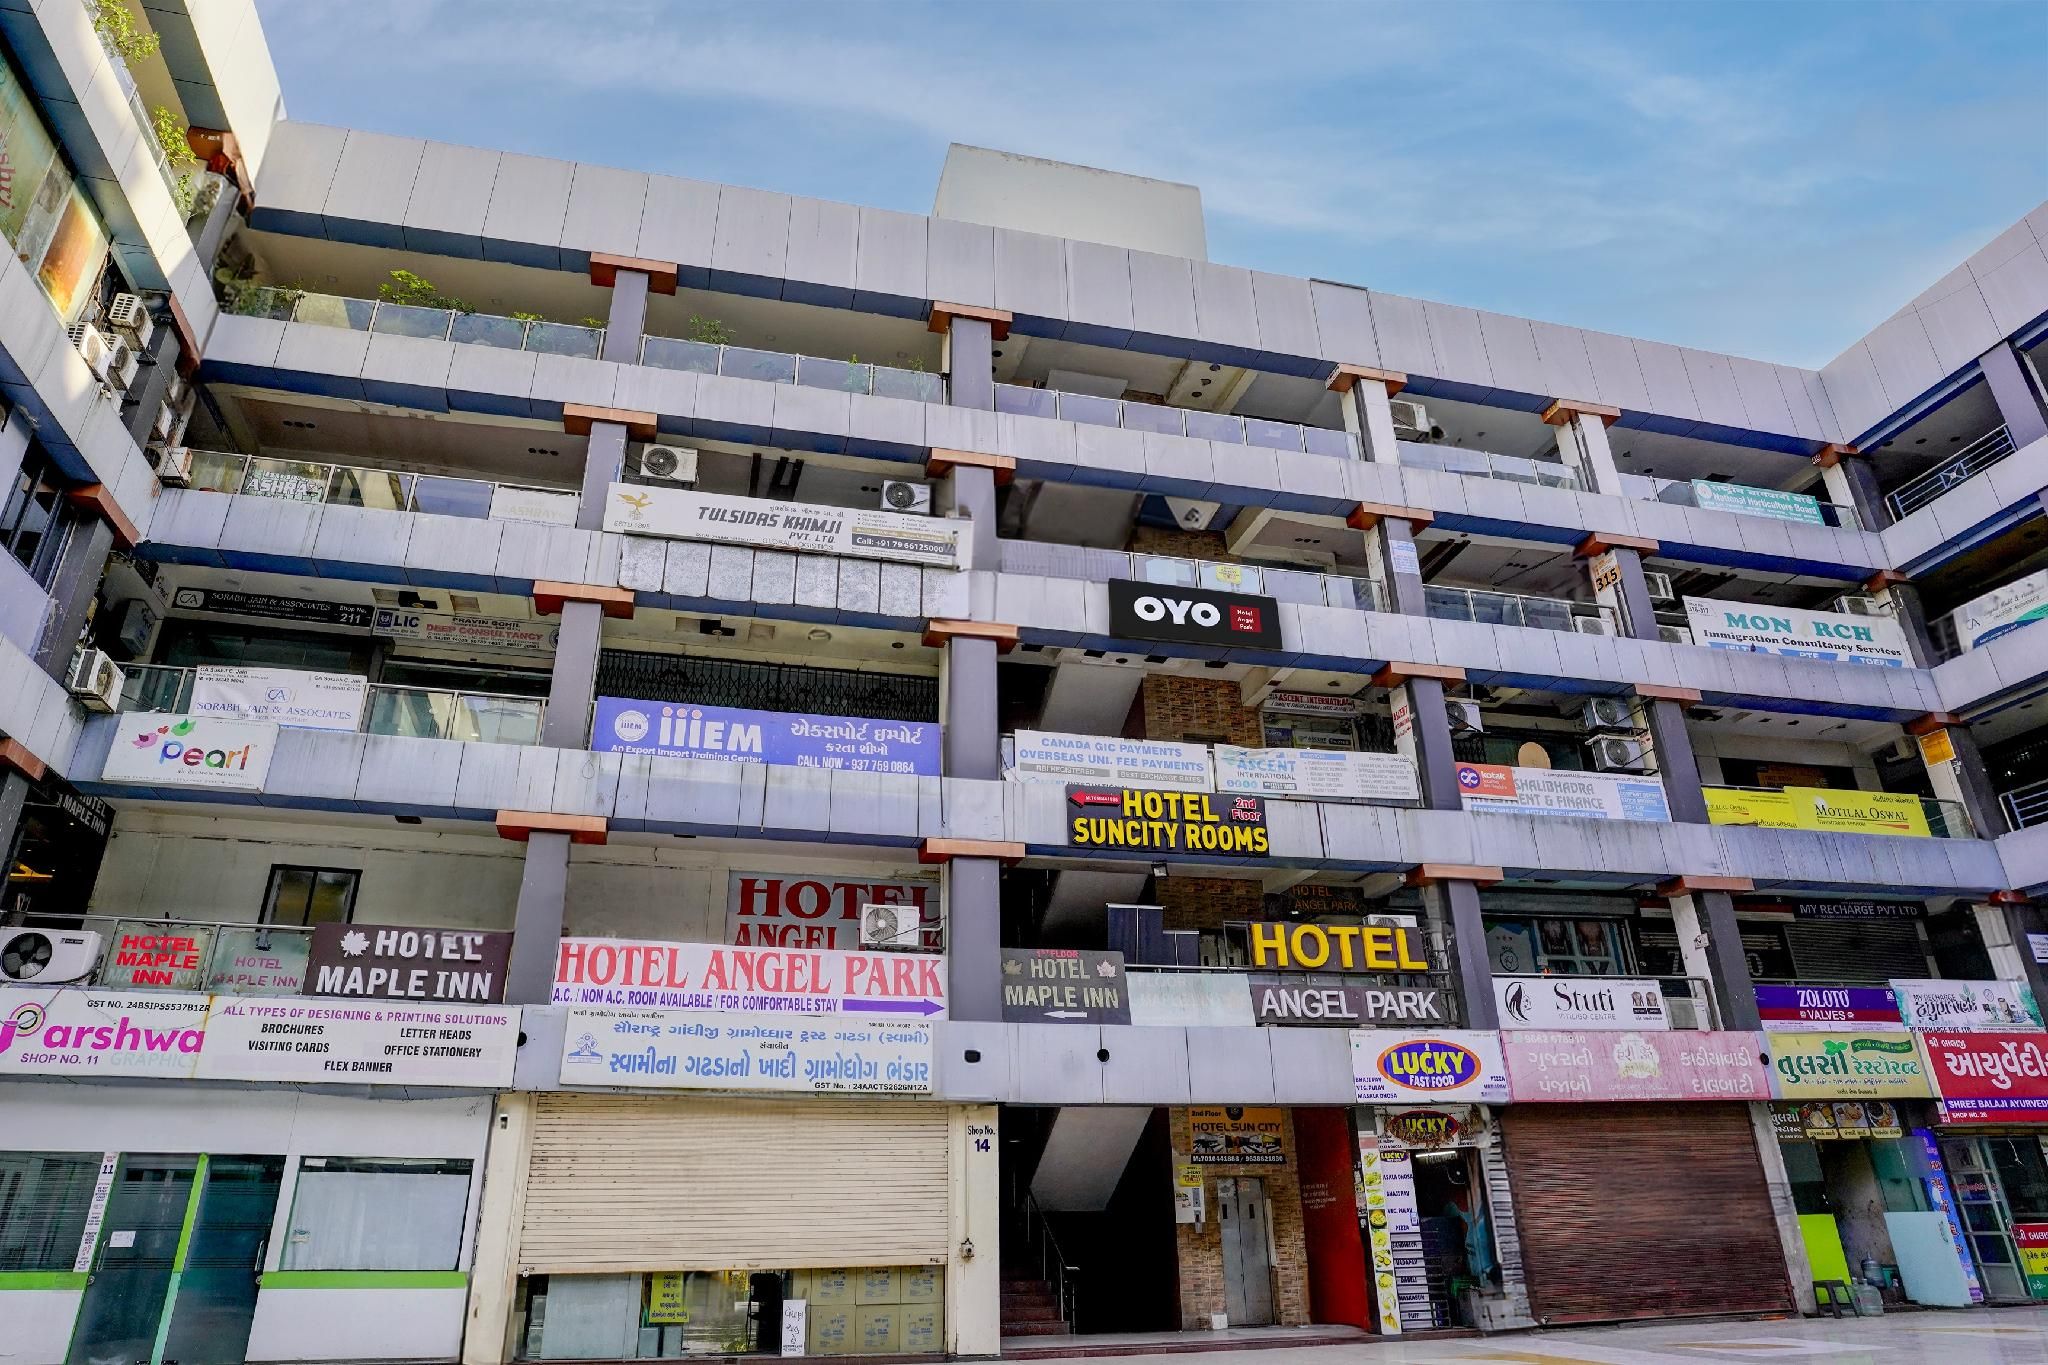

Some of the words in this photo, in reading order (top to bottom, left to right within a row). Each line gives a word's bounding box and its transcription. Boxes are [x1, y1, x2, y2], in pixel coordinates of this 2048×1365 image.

[1713, 493, 1746, 505] National
[1748, 498, 1794, 510] Horticulture
[1795, 504, 1817, 514] Board
[698, 506, 779, 528] TULSIDAS
[783, 515, 842, 534] KHIMJI
[788, 531, 811, 541] PVT.
[856, 537, 874, 545] Call:
[876, 538, 890, 547] +91
[903, 542, 944, 553] 66125000
[1595, 567, 1619, 592] 315
[211, 592, 247, 602] SORABH
[248, 595, 268, 605] JAIN
[270, 597, 278, 606] &
[278, 599, 331, 611] ASSOCIATES
[356, 606, 367, 614] No.
[339, 613, 361, 624] 211
[394, 612, 420, 627] LIC
[1133, 596, 1221, 627] OYO
[426, 623, 456, 633] DEEP
[458, 626, 543, 641] CONSULTANCY
[1703, 629, 1779, 645] Immigration
[1782, 637, 1852, 652] Consultancy
[1856, 644, 1902, 656] Services
[196, 702, 240, 712] SORABH
[246, 704, 268, 715] JAIN
[272, 706, 281, 714] &
[287, 707, 352, 720] ASSOCIATES
[159, 740, 249, 770] pearl
[626, 746, 656, 755] Export
[658, 748, 690, 758] Import
[691, 751, 729, 762] Training
[731, 754, 762, 763] Center
[825, 743, 855, 753] કરતા
[859, 742, 888, 756] શીખો
[1041, 738, 1091, 750] CANADA
[1095, 742, 1115, 752] GIC
[1119, 745, 1182, 758] PAYMENTS
[797, 755, 820, 768] CALL
[822, 757, 843, 769] NOW
[851, 759, 869, 771] 937
[891, 762, 914, 774] 0864
[1020, 749, 1084, 763] OVERSEAS
[1088, 754, 1113, 765] UNI.
[1116, 757, 1138, 768] FEE
[1142, 759, 1204, 772] PAYMENTS
[1236, 759, 1296, 773] ASCENT
[1237, 771, 1296, 781] INTERNATIONAL
[1481, 771, 1505, 780] kotak
[1122, 789, 1220, 822] HOTEL
[1235, 797, 1257, 809] 2nd
[1545, 796, 1553, 806] &
[1555, 796, 1604, 809] FINANCE
[63, 794, 92, 826] MAPLE
[91, 815, 106, 836] INN
[1815, 803, 1867, 819] MOTILAL
[1869, 809, 1908, 821] OSWAL
[1074, 817, 1179, 849] SUNCITY
[1184, 823, 1269, 854] ROOMS
[1231, 809, 1262, 821] Floor
[1291, 886, 1333, 897] HOTEL
[1295, 899, 1330, 910] ANGEL
[1332, 901, 1359, 912] PARK
[1800, 904, 1817, 914] MY
[1819, 905, 1875, 916] RECHARGE
[1876, 906, 1897, 916] PVT
[1899, 906, 1918, 916] LTD
[121, 934, 200, 952] HOTEL
[374, 930, 485, 961] HOTEL
[735, 923, 838, 950] ANGEL
[1251, 923, 1429, 970] HOTEL
[116, 952, 199, 970] MAPLE
[235, 956, 282, 969] HOTEL
[555, 942, 690, 988] HOTEL
[701, 950, 832, 995] ANGEL
[843, 956, 944, 998] PARK
[1030, 959, 1091, 979] HOTEL
[131, 969, 173, 986] INN
[212, 973, 269, 986] MAPLE
[273, 976, 298, 987] INN
[315, 965, 429, 998] MAPLE
[433, 971, 492, 1000] INN
[87, 1000, 105, 1008] GST
[107, 1000, 124, 1009] NO.
[552, 987, 573, 1002] A.C.
[581, 989, 604, 1003] NON
[606, 990, 626, 1005] A.C.
[628, 991, 658, 1006] ROOM
[659, 993, 713, 1008] AVAILABLE
[720, 995, 740, 1009] FOR
[741, 996, 812, 1012] COMFORTABLE
[814, 998, 838, 1012] STAY
[1005, 985, 1078, 1008] MAPLE
[1083, 987, 1120, 1008] INN
[1260, 989, 1359, 1018] ANGEL
[1365, 991, 1441, 1019] PARK
[1553, 982, 1615, 1012] Stuti
[1797, 989, 1850, 1008] ZOLOTO
[223, 1006, 246, 1017] ALL
[249, 1007, 286, 1018] TYPES
[290, 1008, 304, 1018] OF
[307, 1009, 371, 1021] DESIGNING
[374, 1012, 383, 1021] &
[387, 1012, 441, 1024] PRINTING
[444, 1014, 508, 1026] SOLUTIONS
[1806, 1010, 1846, 1021] VALVES
[261, 1023, 324, 1035] BROCHURES
[400, 1028, 437, 1040] LETTER
[439, 1029, 472, 1041] HEADS
[613, 1020, 660, 1038] સૌરાષ્ટ્ર
[668, 1023, 719, 1039] ગાંધીજી
[800, 1030, 827, 1043] ટ્રસ્ટ
[834, 1032, 871, 1042] ગઢડા
[878, 1030, 929, 1045] (સ્વામી)
[248, 1040, 292, 1052] VISITING
[296, 1041, 330, 1053] CARDS
[384, 1045, 419, 1056] OFFICE
[422, 1046, 482, 1058] STATIONERY
[1929, 1037, 1938, 1048] શ્રી
[20, 1054, 57, 1064] SHOP
[60, 1055, 82, 1065] NO.
[87, 1056, 98, 1065] 11
[110, 1053, 198, 1068] GRAPHICS
[609, 1046, 677, 1075] સ્વામીના
[685, 1049, 750, 1077] ગઢડાનો
[759, 1051, 796, 1079] ખાદી
[887, 1055, 929, 1082] ભંડાર
[1391, 1052, 1464, 1075] LUCKY
[1528, 1049, 1593, 1071] ગુજરાતી
[1681, 1047, 1753, 1067] કાઠીયાવાડી
[1777, 1046, 1848, 1084] તુલસી
[324, 1061, 349, 1071] FLEX
[351, 1061, 393, 1073] BANNER
[1410, 1075, 1430, 1087] FAST
[1431, 1075, 1455, 1087] FOOD
[1540, 1073, 1591, 1094] પંજાબી
[1693, 1073, 1754, 1094] દાલબાટી
[968, 1125, 984, 1136] Shop
[985, 1125, 996, 1135] No.
[1193, 1123, 1230, 1132] HOTEL
[1231, 1123, 1256, 1132] SUN
[1257, 1123, 1281, 1132] CITY
[1399, 1118, 1447, 1132] LUCKY
[975, 1139, 990, 1152] 14
[1381, 1152, 1405, 1160] LUCKY
[102, 1165, 114, 1174] 11
